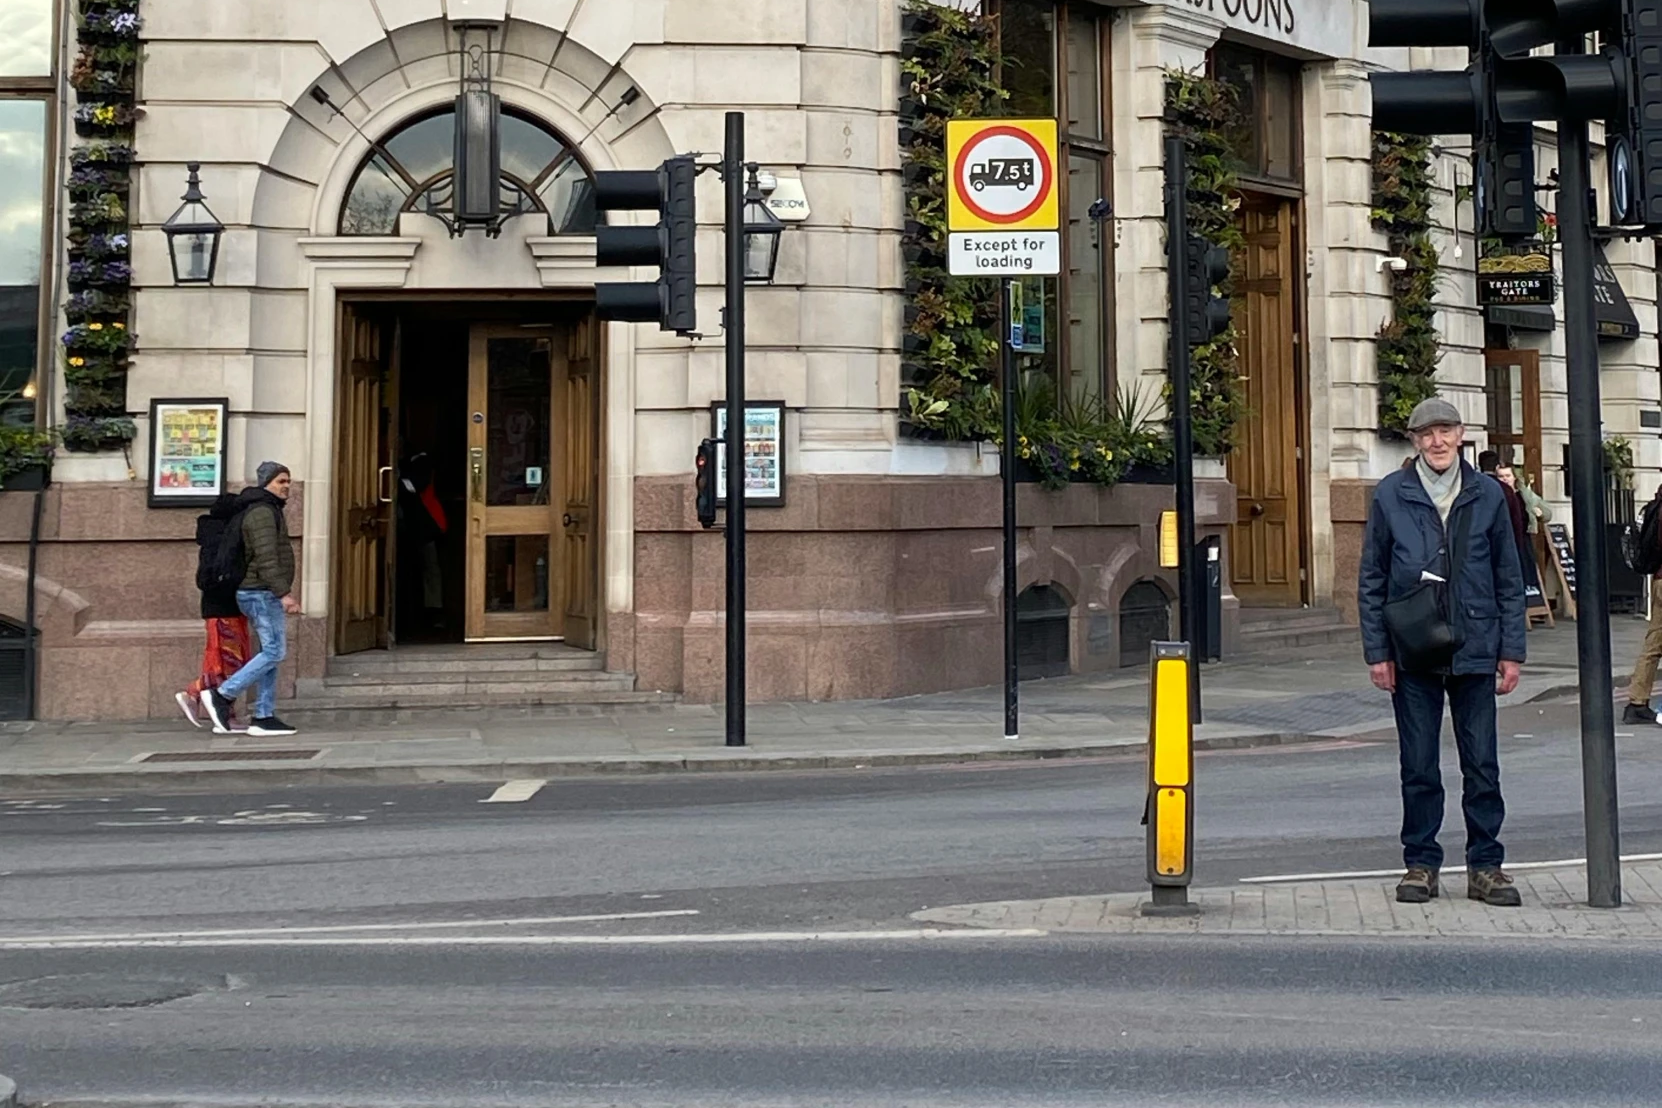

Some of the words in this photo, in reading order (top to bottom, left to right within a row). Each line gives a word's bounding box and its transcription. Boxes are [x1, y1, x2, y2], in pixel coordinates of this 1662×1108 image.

[964, 238, 1018, 253] Except
[1023, 238, 1045, 250] for
[976, 255, 1033, 269] loading
[1489, 280, 1540, 288] TRAITORS
[1501, 287, 1529, 296] GATE
